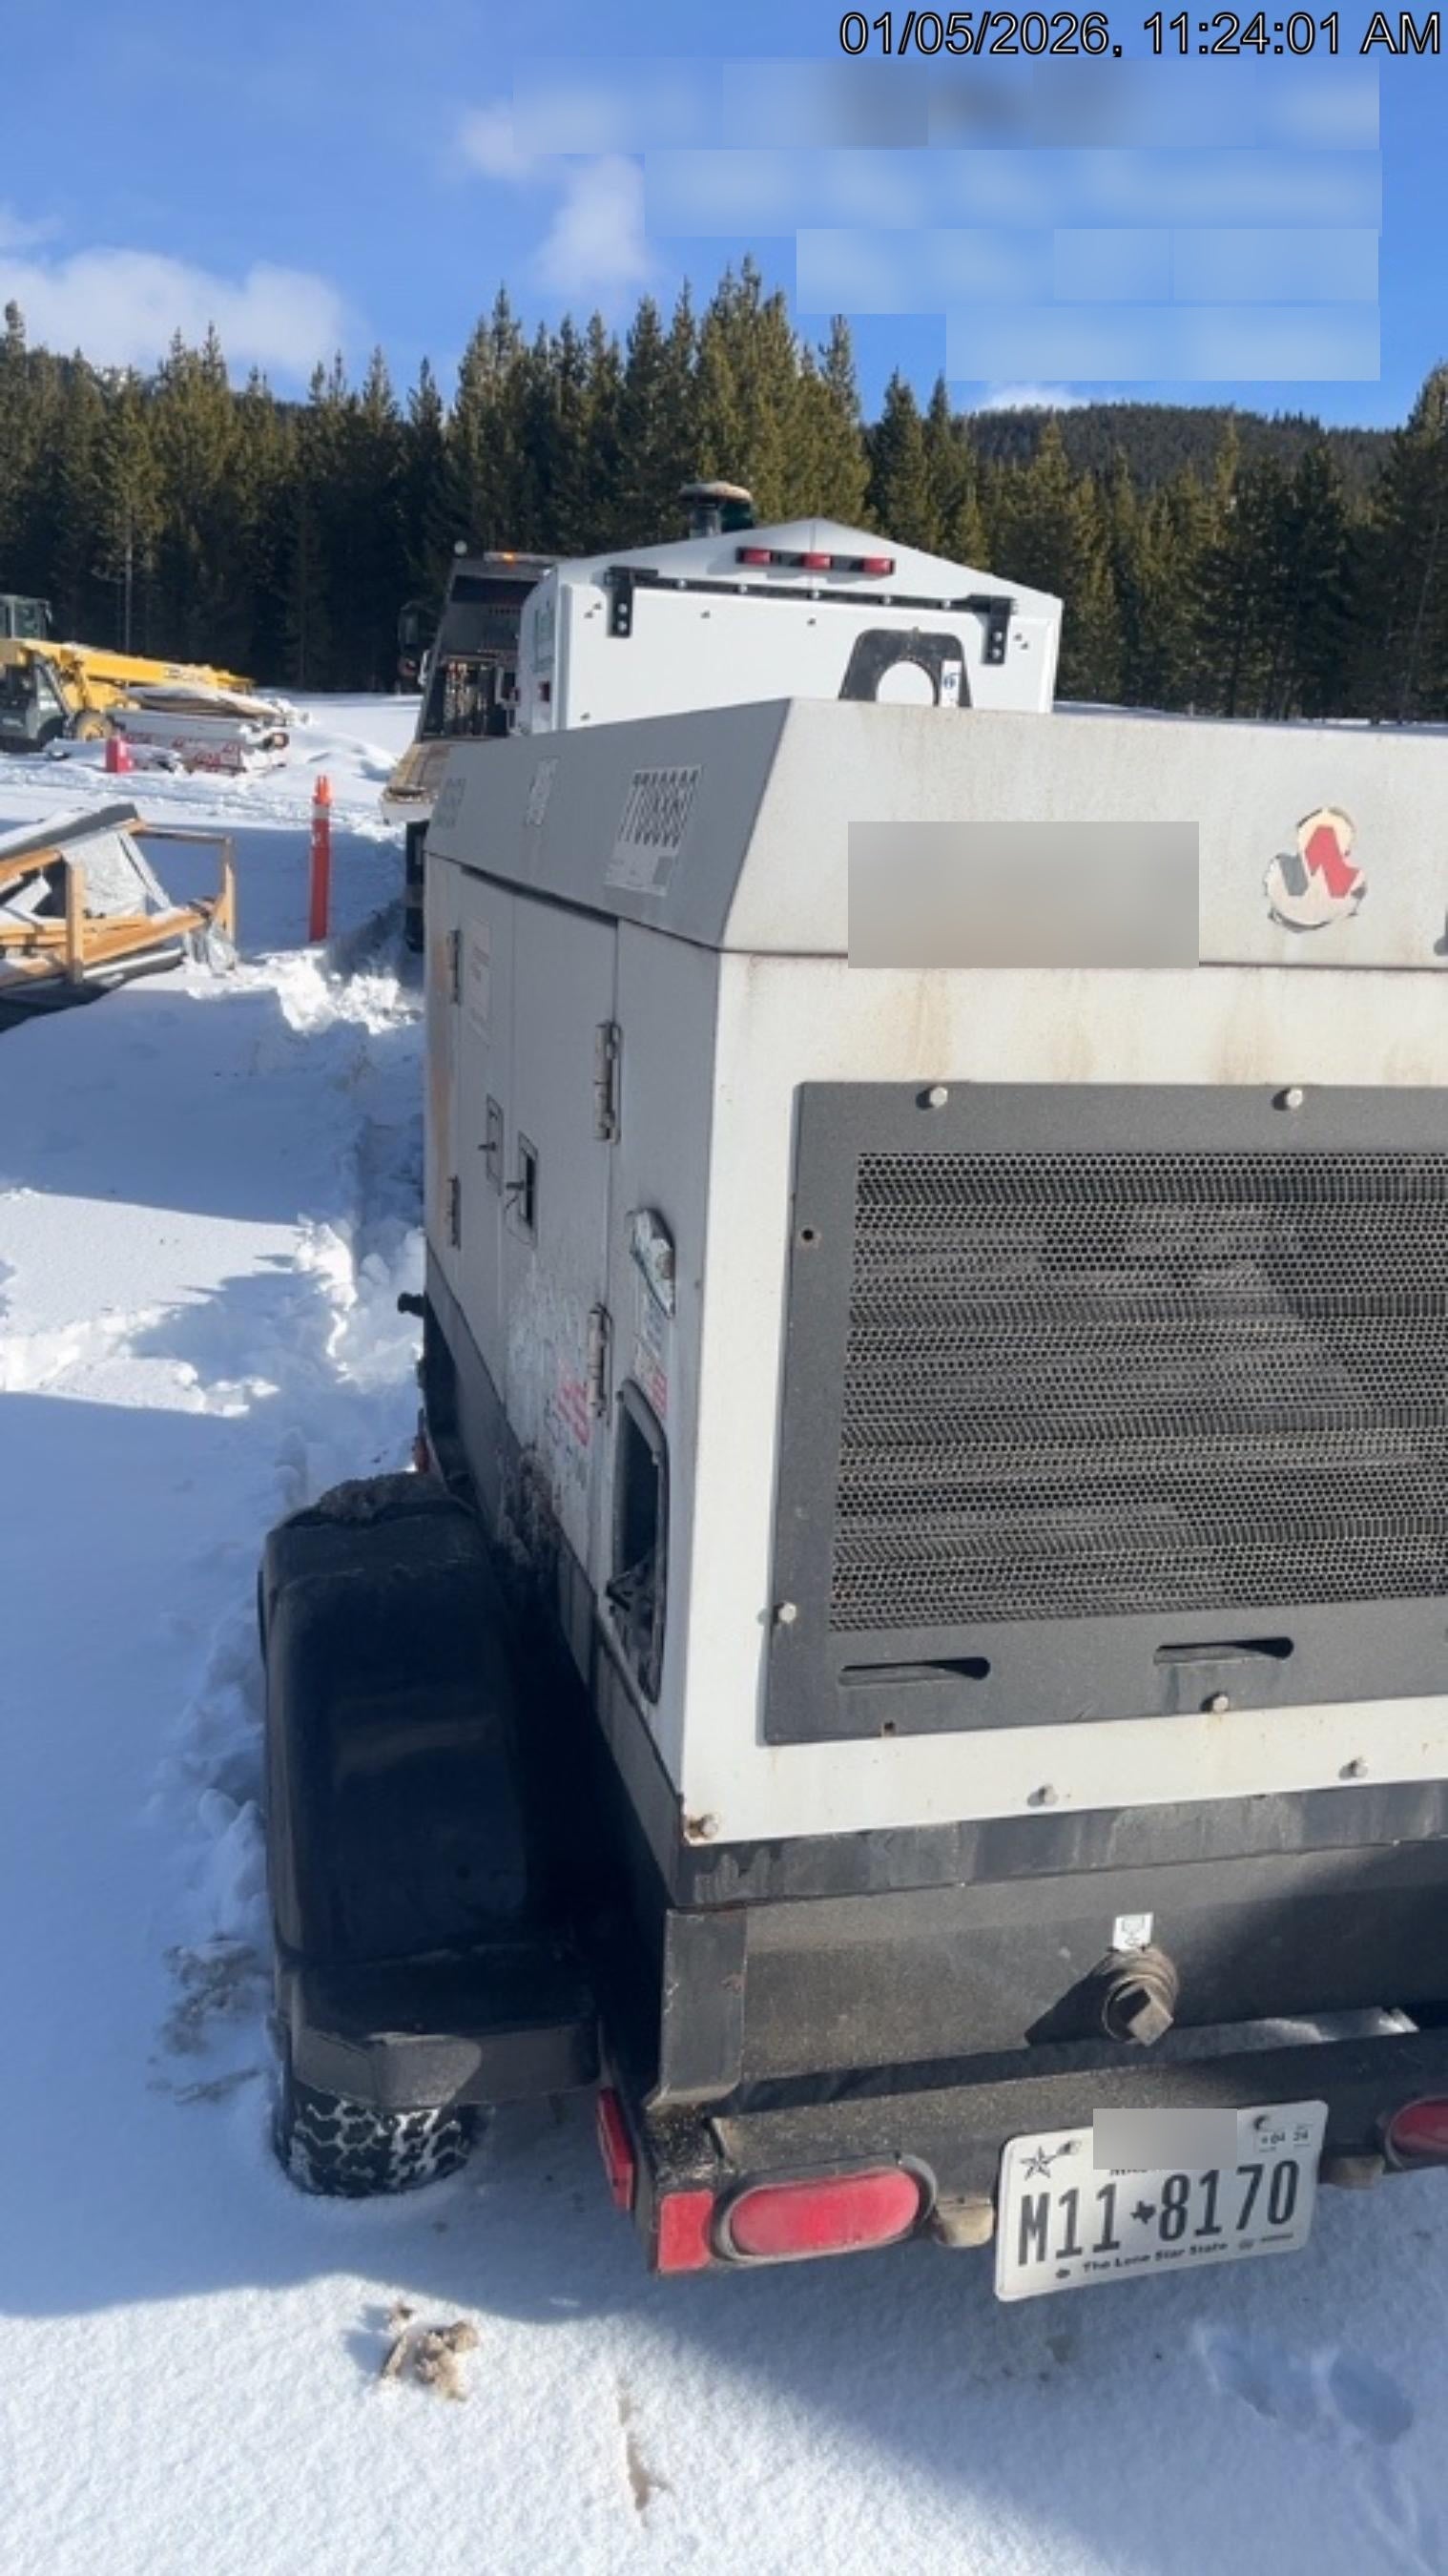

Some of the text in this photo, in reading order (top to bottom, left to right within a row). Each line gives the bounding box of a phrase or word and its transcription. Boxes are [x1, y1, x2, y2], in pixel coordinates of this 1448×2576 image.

[1083, 2260, 1111, 2273] The
[1114, 2254, 1151, 2268] Lone
[1155, 2248, 1186, 2261] Star
[1189, 2241, 1229, 2255] State
